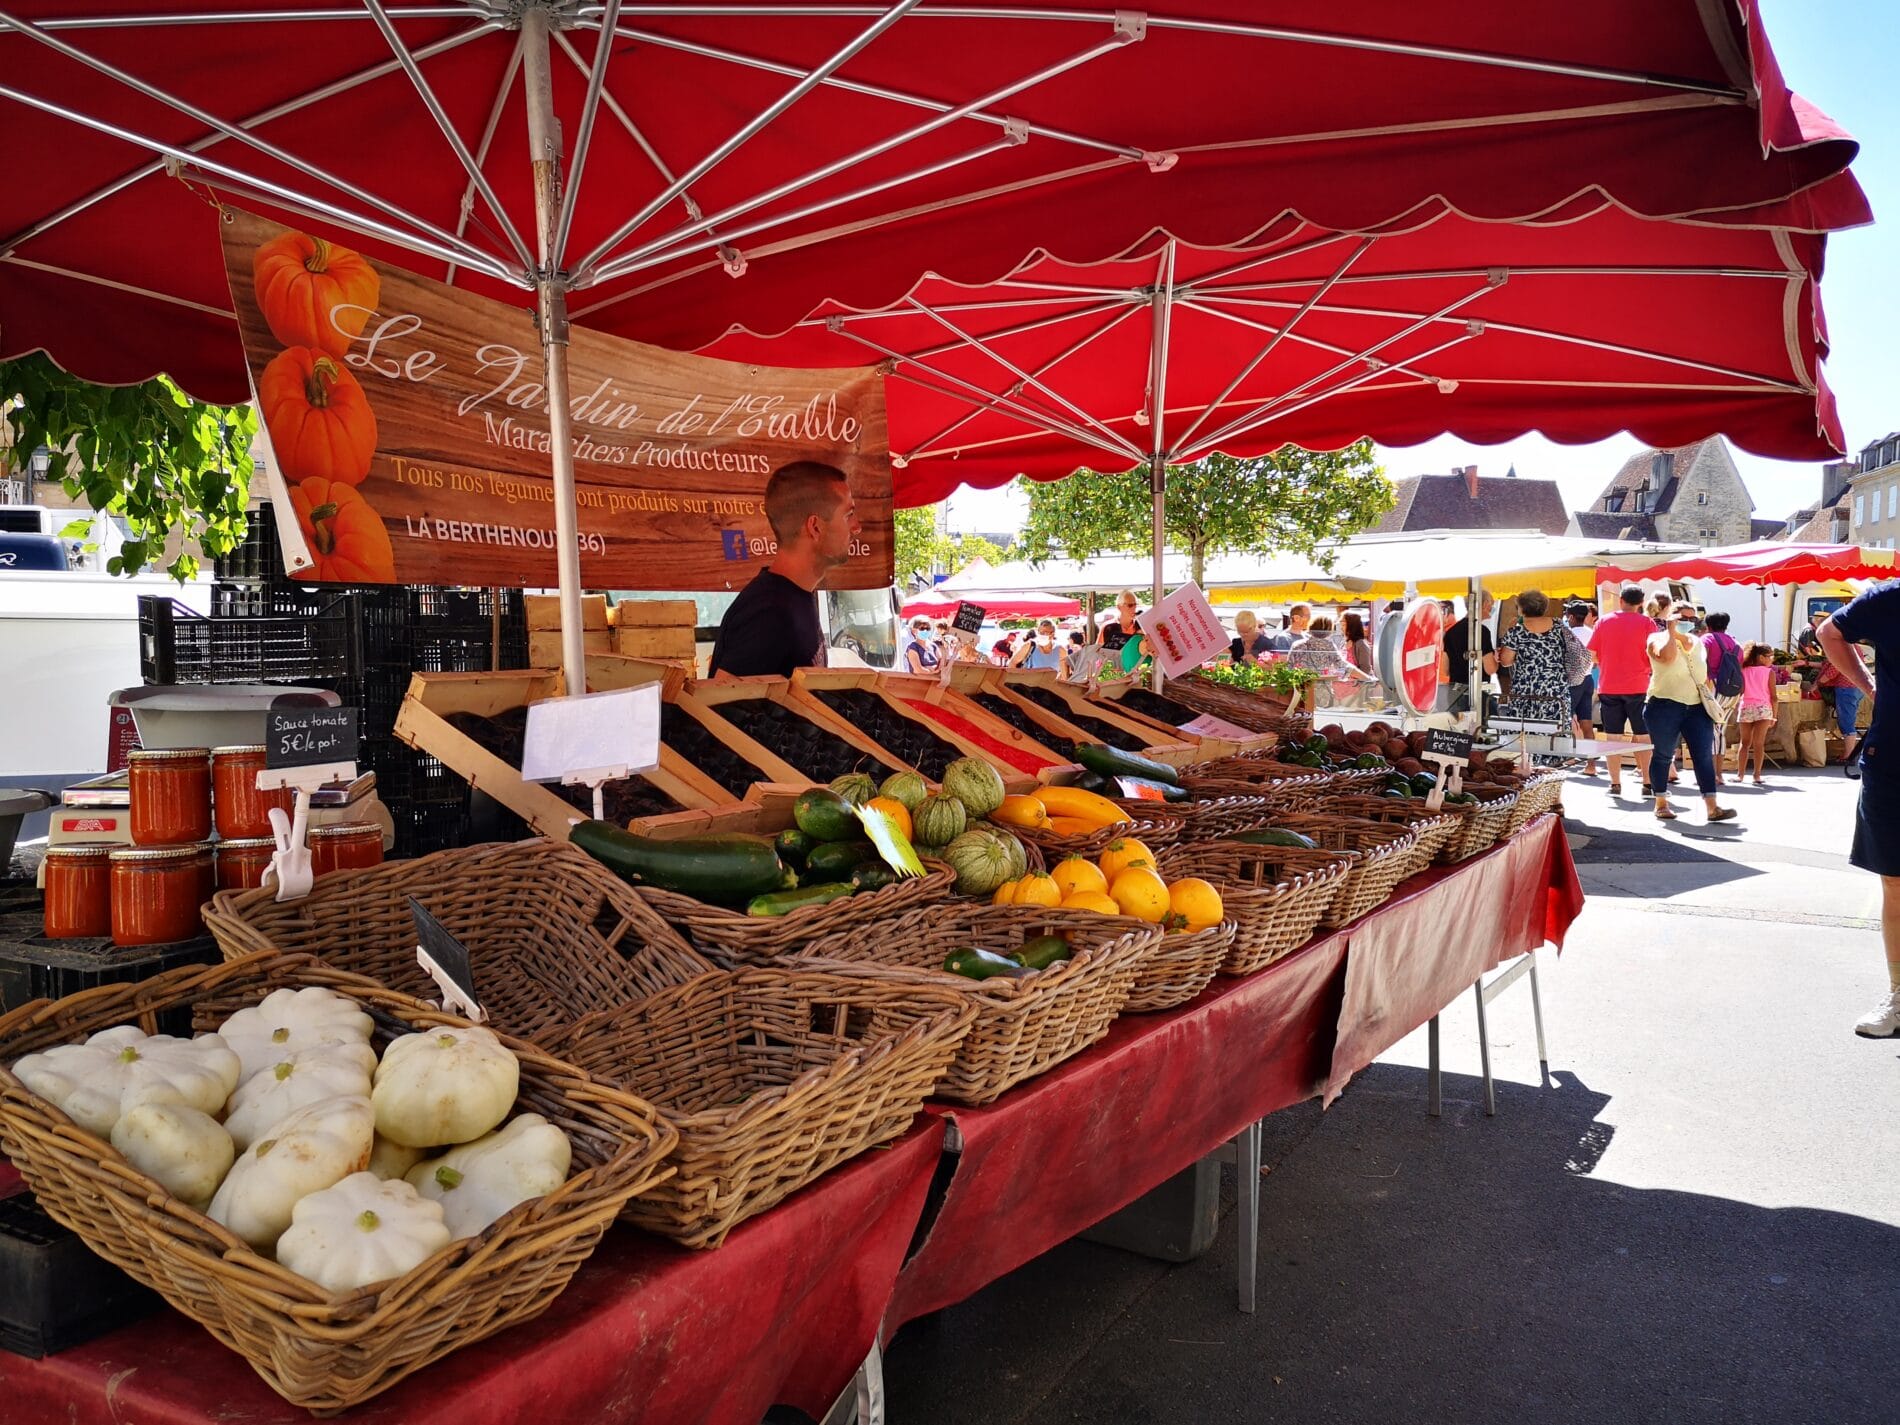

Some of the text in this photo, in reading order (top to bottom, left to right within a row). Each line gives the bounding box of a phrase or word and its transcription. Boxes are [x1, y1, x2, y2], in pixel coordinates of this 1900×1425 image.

[330, 303, 447, 382] Le
[458, 344, 648, 430] Jadin
[655, 394, 713, 435] de
[484, 411, 770, 474] Marahers Producteurs
[391, 457, 443, 487] Tous
[450, 471, 484, 493] nos
[489, 471, 553, 503] légume
[576, 489, 604, 507] ont
[607, 491, 678, 514] produits
[683, 497, 709, 514] sur
[713, 496, 754, 515] notre
[406, 515, 432, 539] LA
[577, 532, 606, 556] 36)
[1194, 609, 1209, 630] tomates
[274, 712, 348, 731] Sauce tomate
